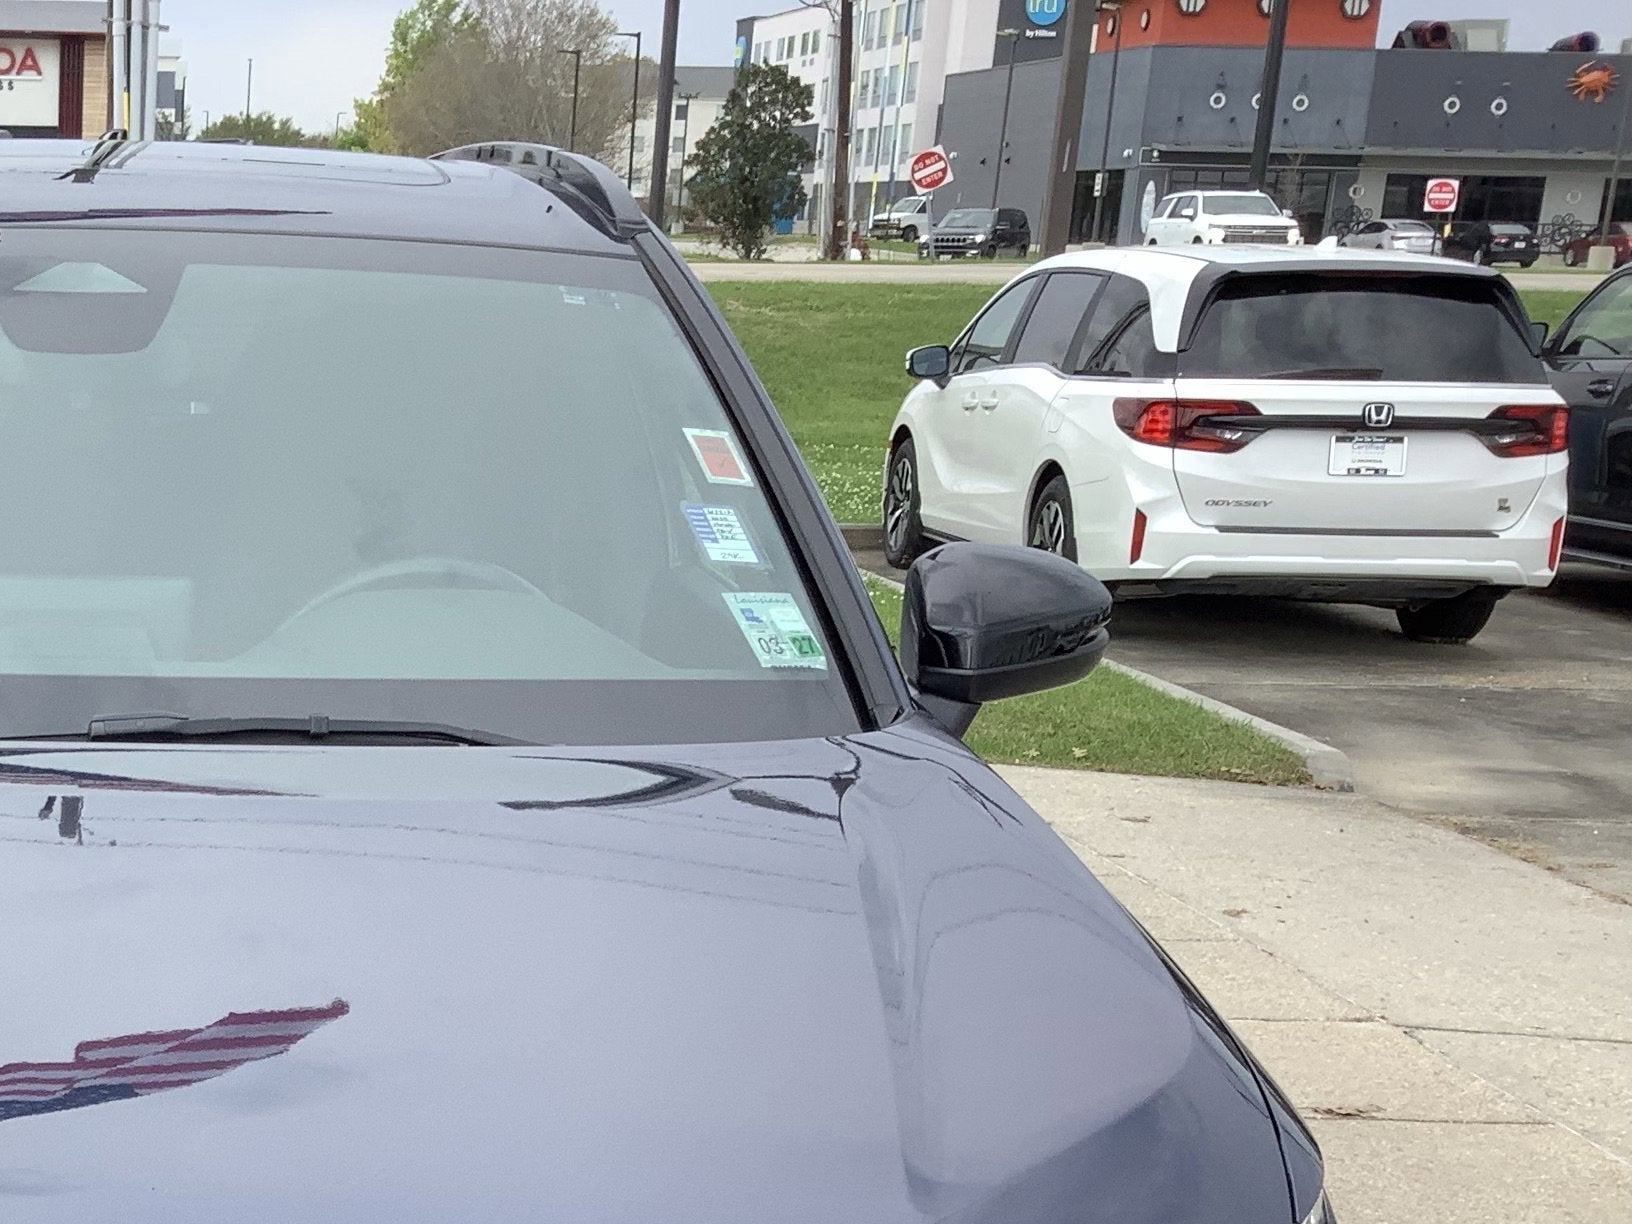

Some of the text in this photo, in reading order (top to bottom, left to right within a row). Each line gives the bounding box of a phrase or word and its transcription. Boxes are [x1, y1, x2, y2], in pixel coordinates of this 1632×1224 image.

[913, 154, 939, 171] DO NOT
[921, 171, 943, 186] ENTER
[1204, 499, 1273, 507] ODYSSEY
[791, 636, 816, 655] 27
